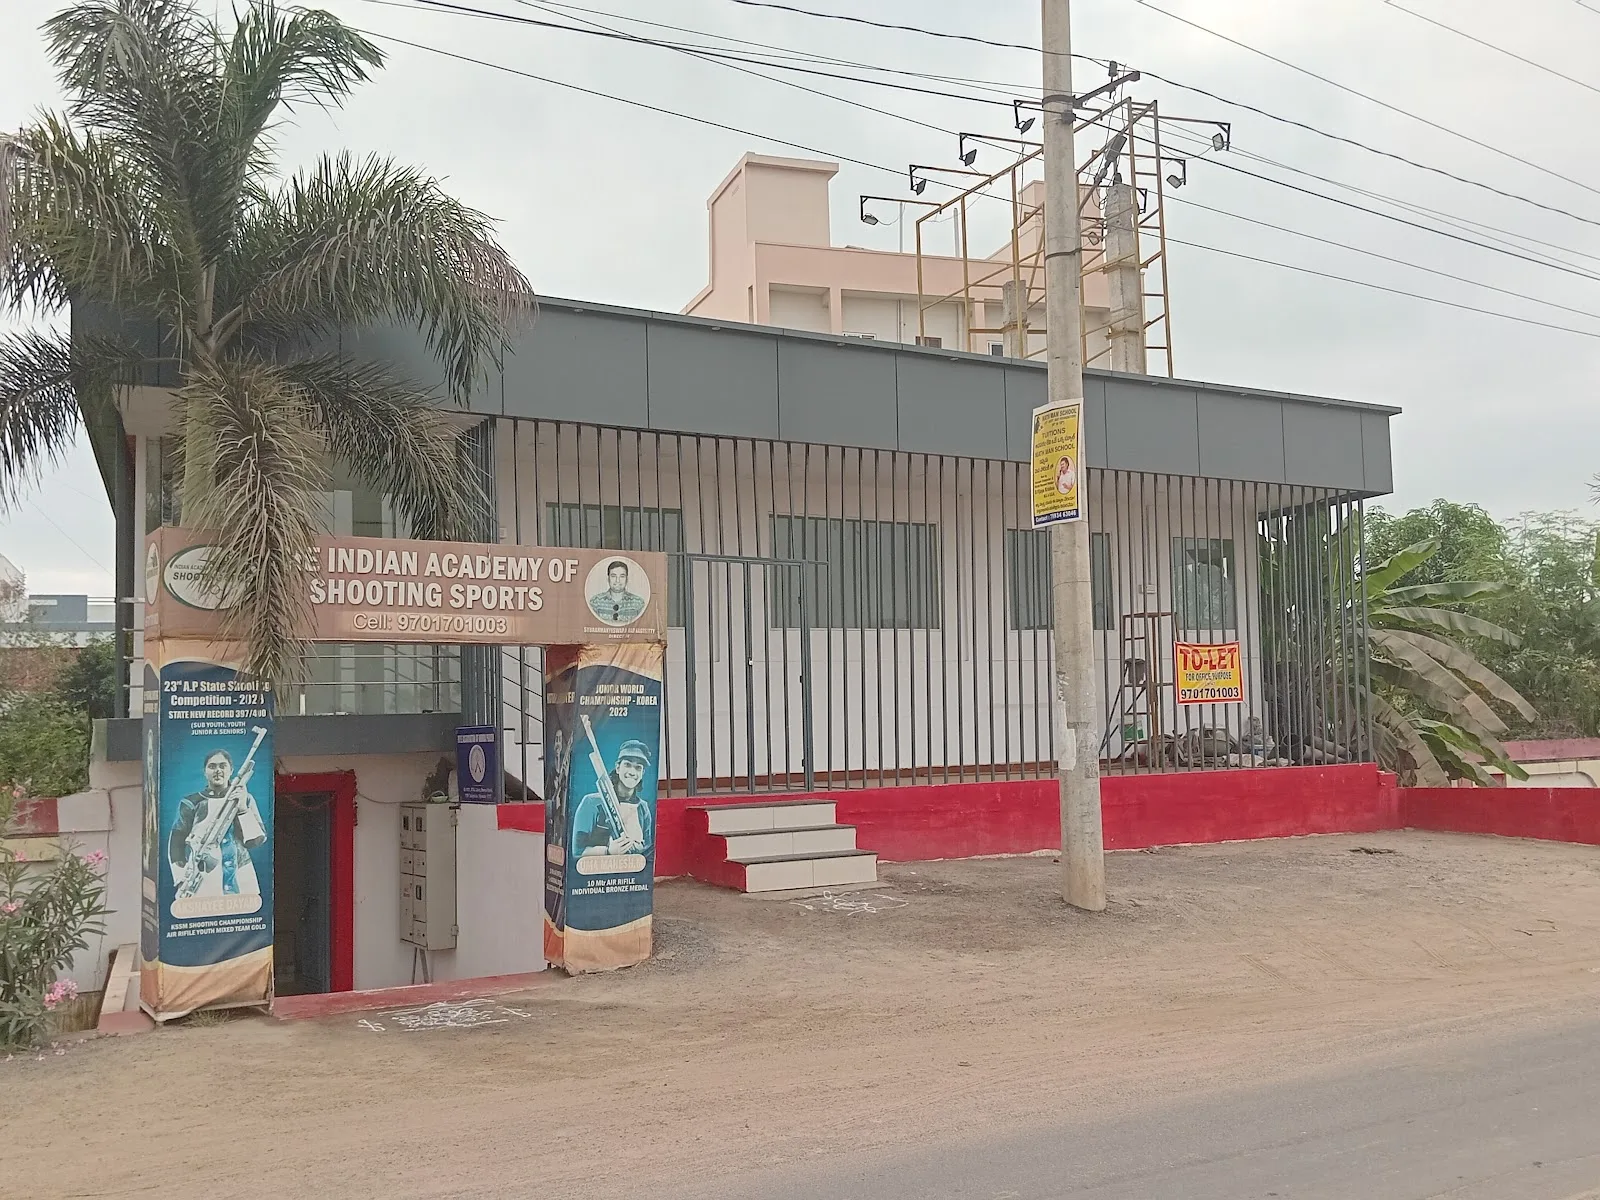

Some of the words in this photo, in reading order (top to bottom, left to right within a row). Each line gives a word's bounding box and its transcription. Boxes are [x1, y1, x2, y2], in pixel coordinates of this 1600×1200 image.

[1059, 408, 1077, 416] SCHOOL
[1042, 427, 1066, 439] TUITIONS
[1054, 443, 1076, 453] SCHOOL
[328, 547, 418, 576] INDIAN
[424, 552, 544, 582] ACADEMY
[548, 558, 580, 583] OF
[309, 578, 442, 609] SHOOTING
[449, 584, 544, 611] SPORTS
[353, 613, 392, 630] Cell:
[397, 613, 508, 634] 9701701003
[1180, 648, 1237, 670] TO-LET
[1185, 672, 1195, 681] FOR
[1195, 672, 1212, 681] OFFICE
[1212, 671, 1232, 680] PURPOSE
[183, 681, 199, 692] A.P
[200, 681, 226, 692] State
[595, 684, 620, 694] JUNIOR
[620, 684, 645, 694] WORLD
[1180, 687, 1239, 699] 9701701003
[170, 694, 232, 706] Competition
[579, 695, 632, 706] CHAMPIONSHIP
[636, 695, 658, 706] KOREA
[168, 710, 189, 719] STATE
[190, 710, 206, 719] NEW
[207, 709, 235, 719] RECORD
[609, 706, 628, 717] 2023
[191, 721, 206, 729] (SUB
[606, 878, 617, 886] AIR
[571, 887, 606, 896] INDIVIDUAL
[605, 885, 629, 894] BRONZE
[629, 884, 649, 892] MEDAL
[188, 920, 218, 929] SHOOTING
[218, 917, 263, 926] CHAMPIONSHIP
[196, 927, 215, 935] YOUTH
[216, 926, 235, 934] MIXED
[234, 924, 250, 932] TEAM
[250, 923, 267, 931] GOLD
